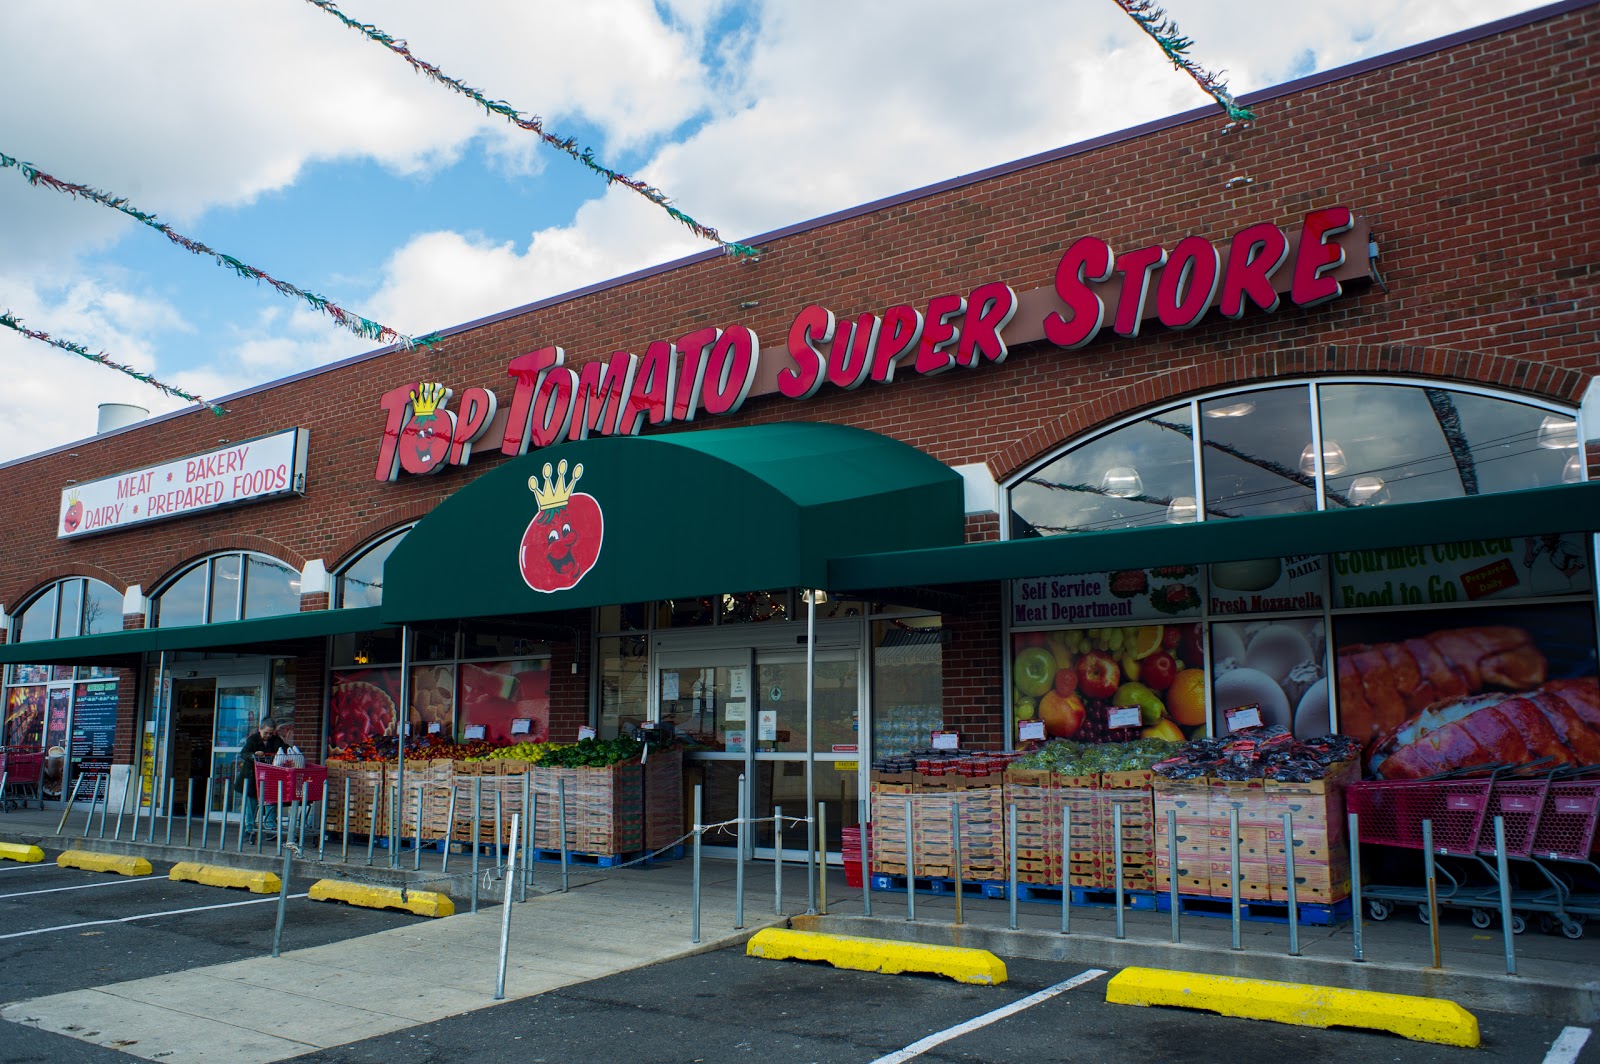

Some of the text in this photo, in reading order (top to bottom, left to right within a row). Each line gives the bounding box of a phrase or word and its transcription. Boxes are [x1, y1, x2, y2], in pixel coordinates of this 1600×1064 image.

[501, 324, 760, 456] TOMATO
[776, 304, 1018, 399] SUPER
[1042, 206, 1355, 350] STORE
[117, 446, 250, 501] MEAT BAKERY
[84, 463, 287, 530] DAIRY PREPARED FOODS
[1287, 559, 1322, 579] DAILY
[1465, 562, 1509, 584] Prepared
[1022, 579, 1101, 600] Self Service
[1341, 575, 1457, 609] Food to Go
[1479, 579, 1504, 592] Daily
[1015, 599, 1132, 622] Meat Department
[1212, 592, 1322, 613] Fresh Mozzarella
